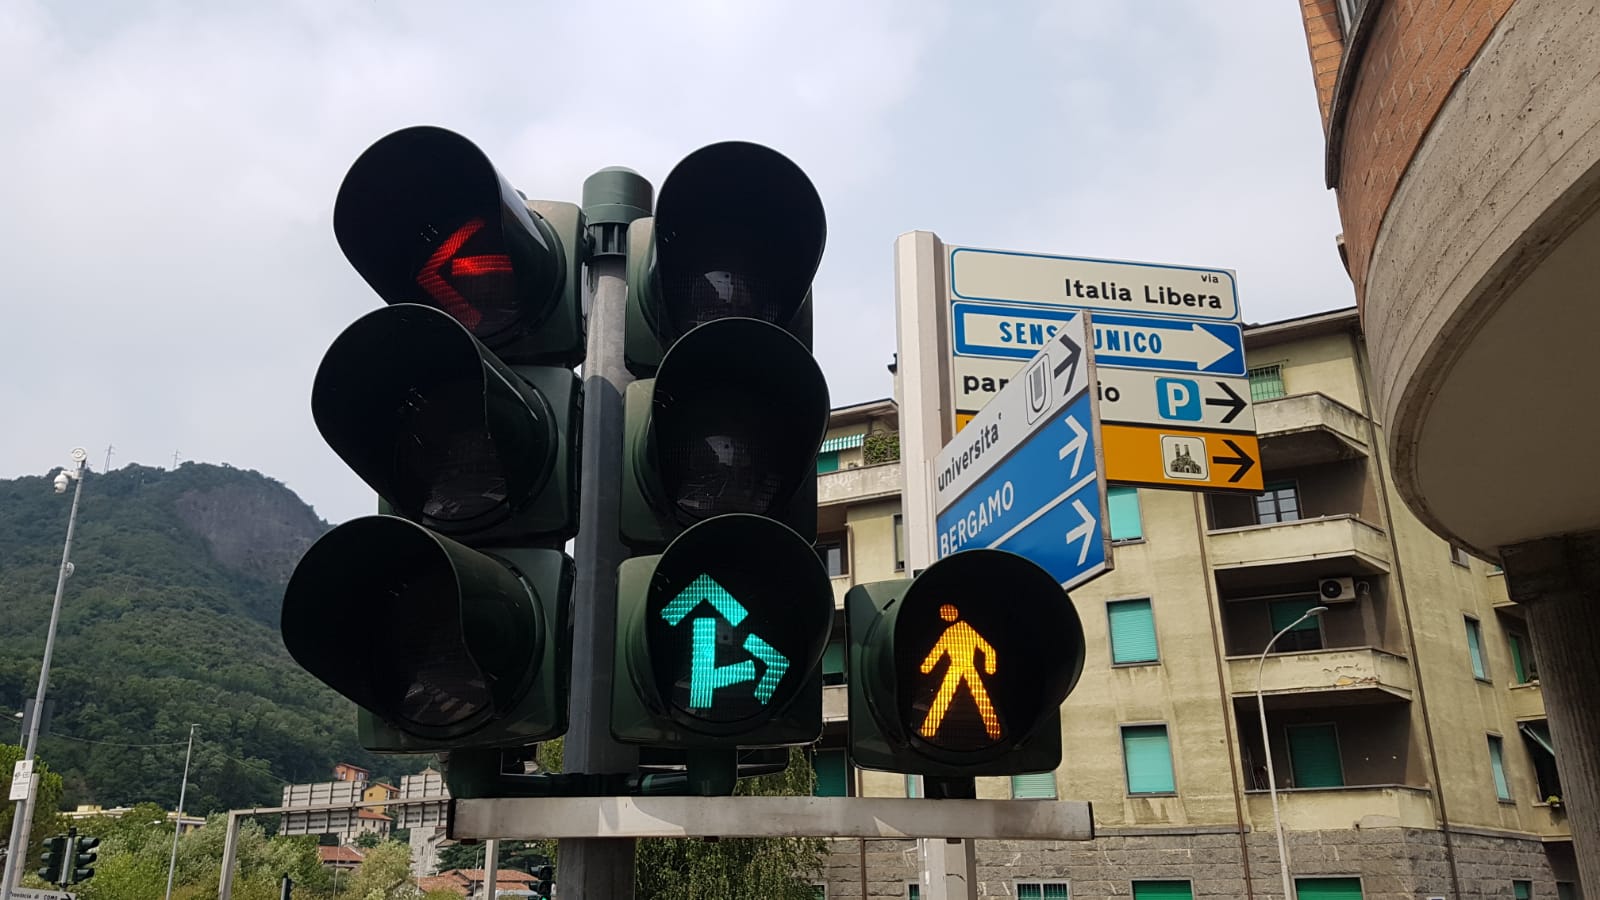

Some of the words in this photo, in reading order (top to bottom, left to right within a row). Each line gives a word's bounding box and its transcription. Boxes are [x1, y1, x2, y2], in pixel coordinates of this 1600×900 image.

[1065, 278, 1132, 302] Italia
[1144, 285, 1222, 309] Libera
[1201, 273, 1219, 284] via
[999, 321, 1058, 346] SENS
[1166, 382, 1190, 416] P
[940, 480, 1014, 560] BERGAMO
